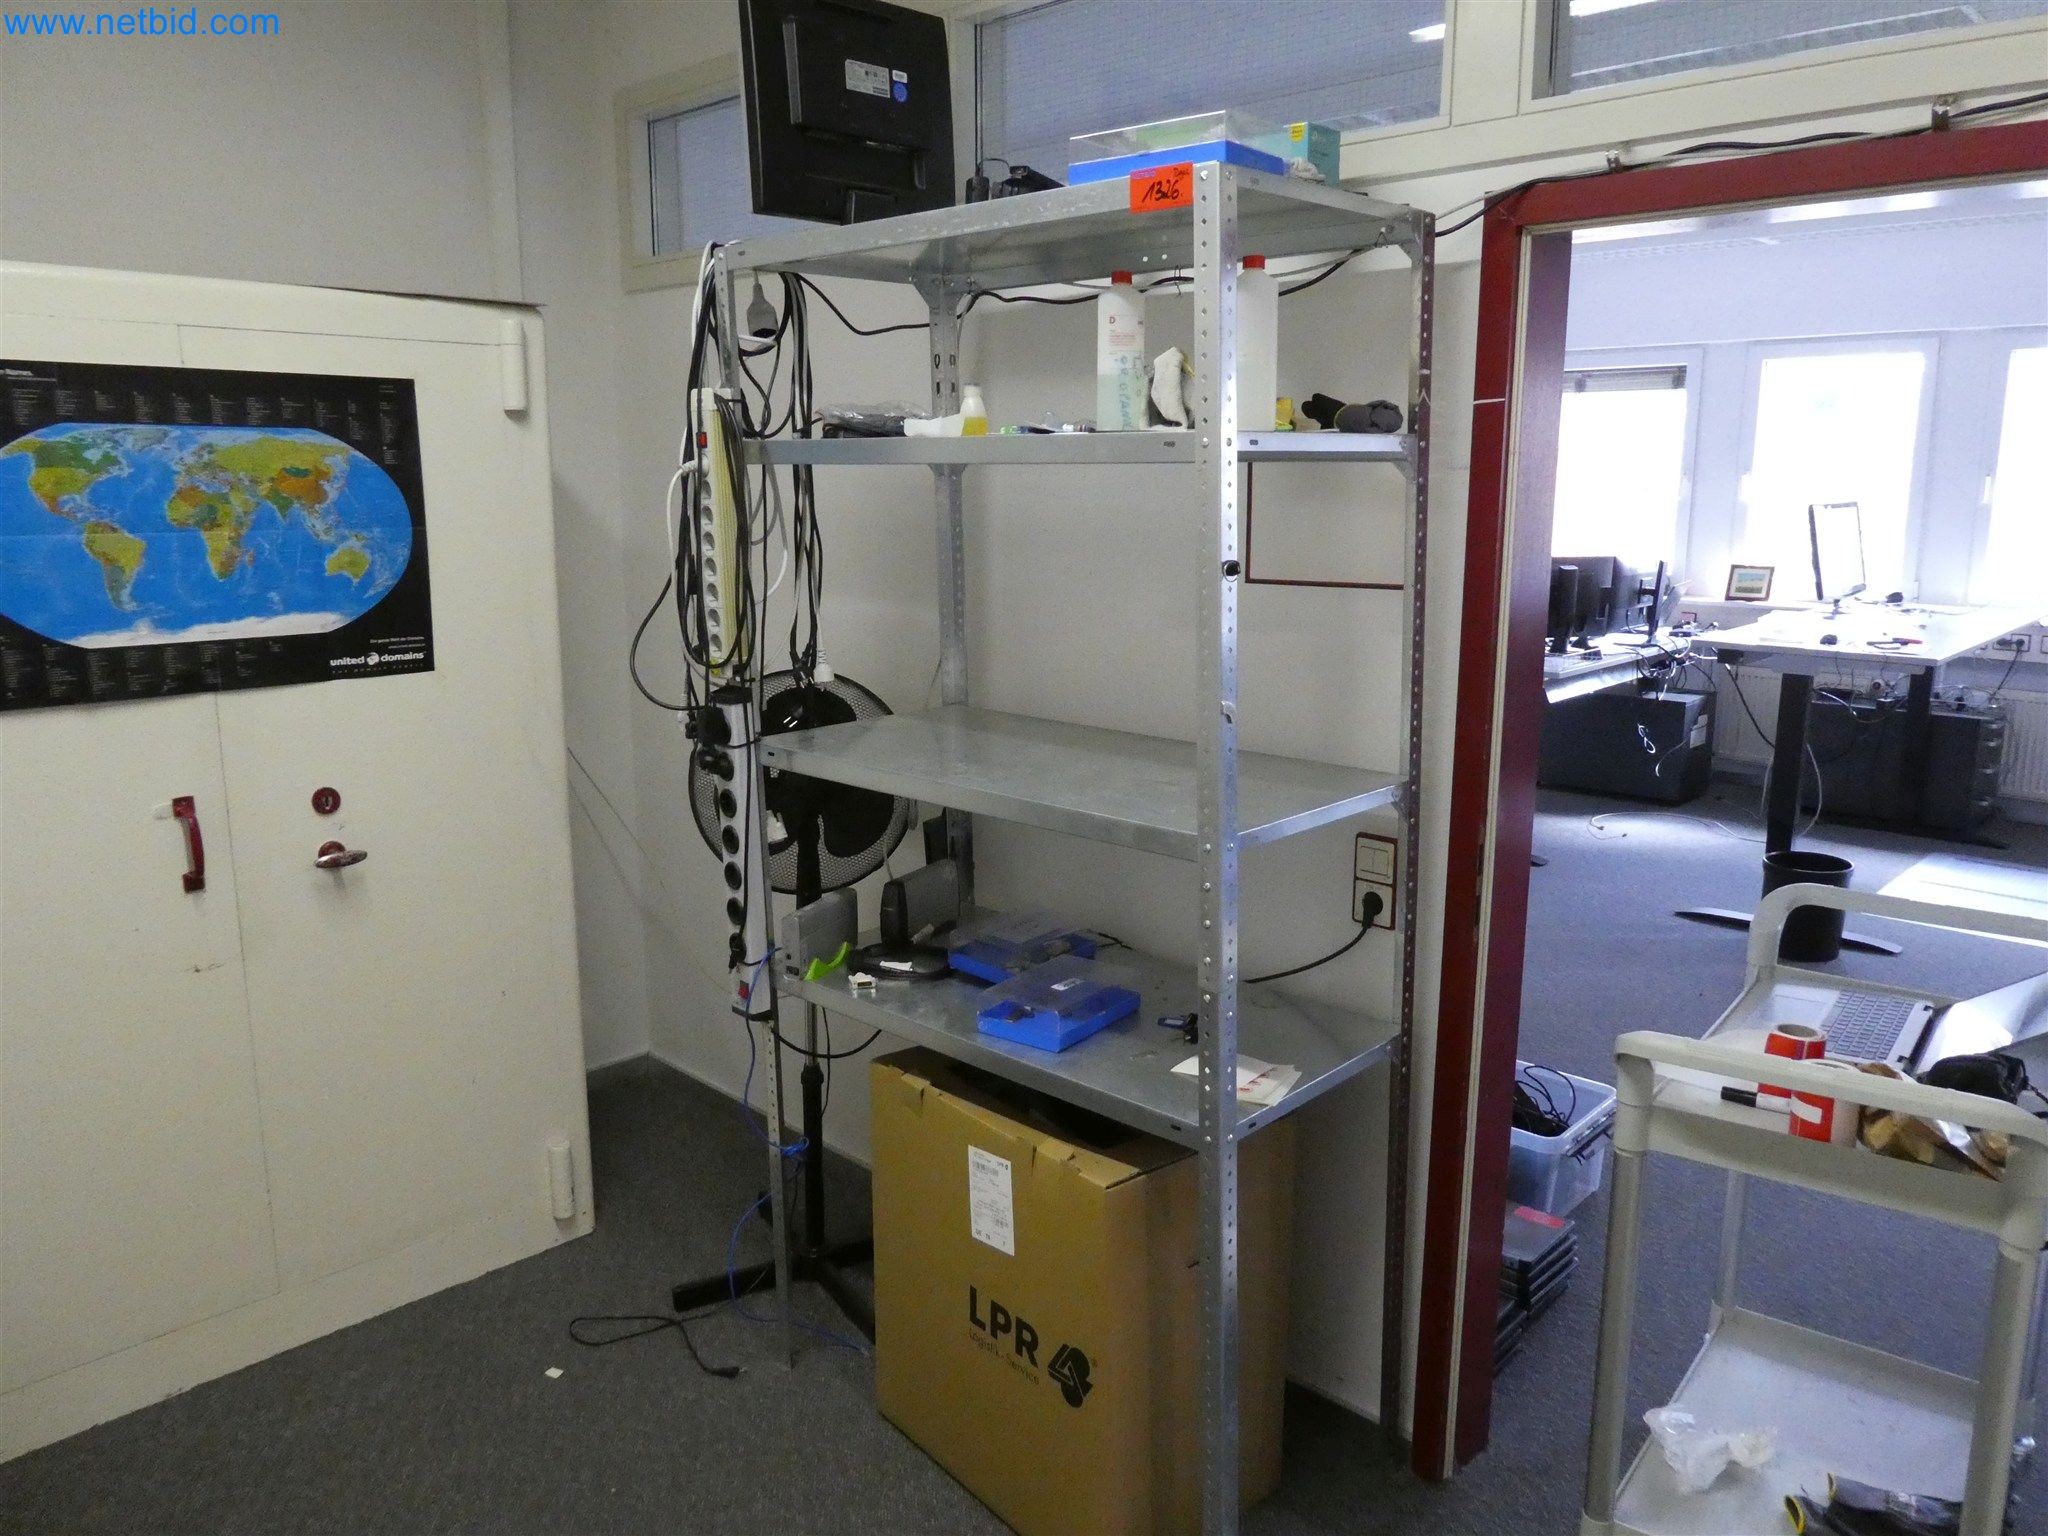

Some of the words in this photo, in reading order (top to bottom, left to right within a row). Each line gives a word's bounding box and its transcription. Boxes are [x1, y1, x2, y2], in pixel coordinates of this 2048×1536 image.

[330, 655, 365, 666] united
[380, 652, 425, 662] domains
[969, 1284, 1039, 1369] LPR
